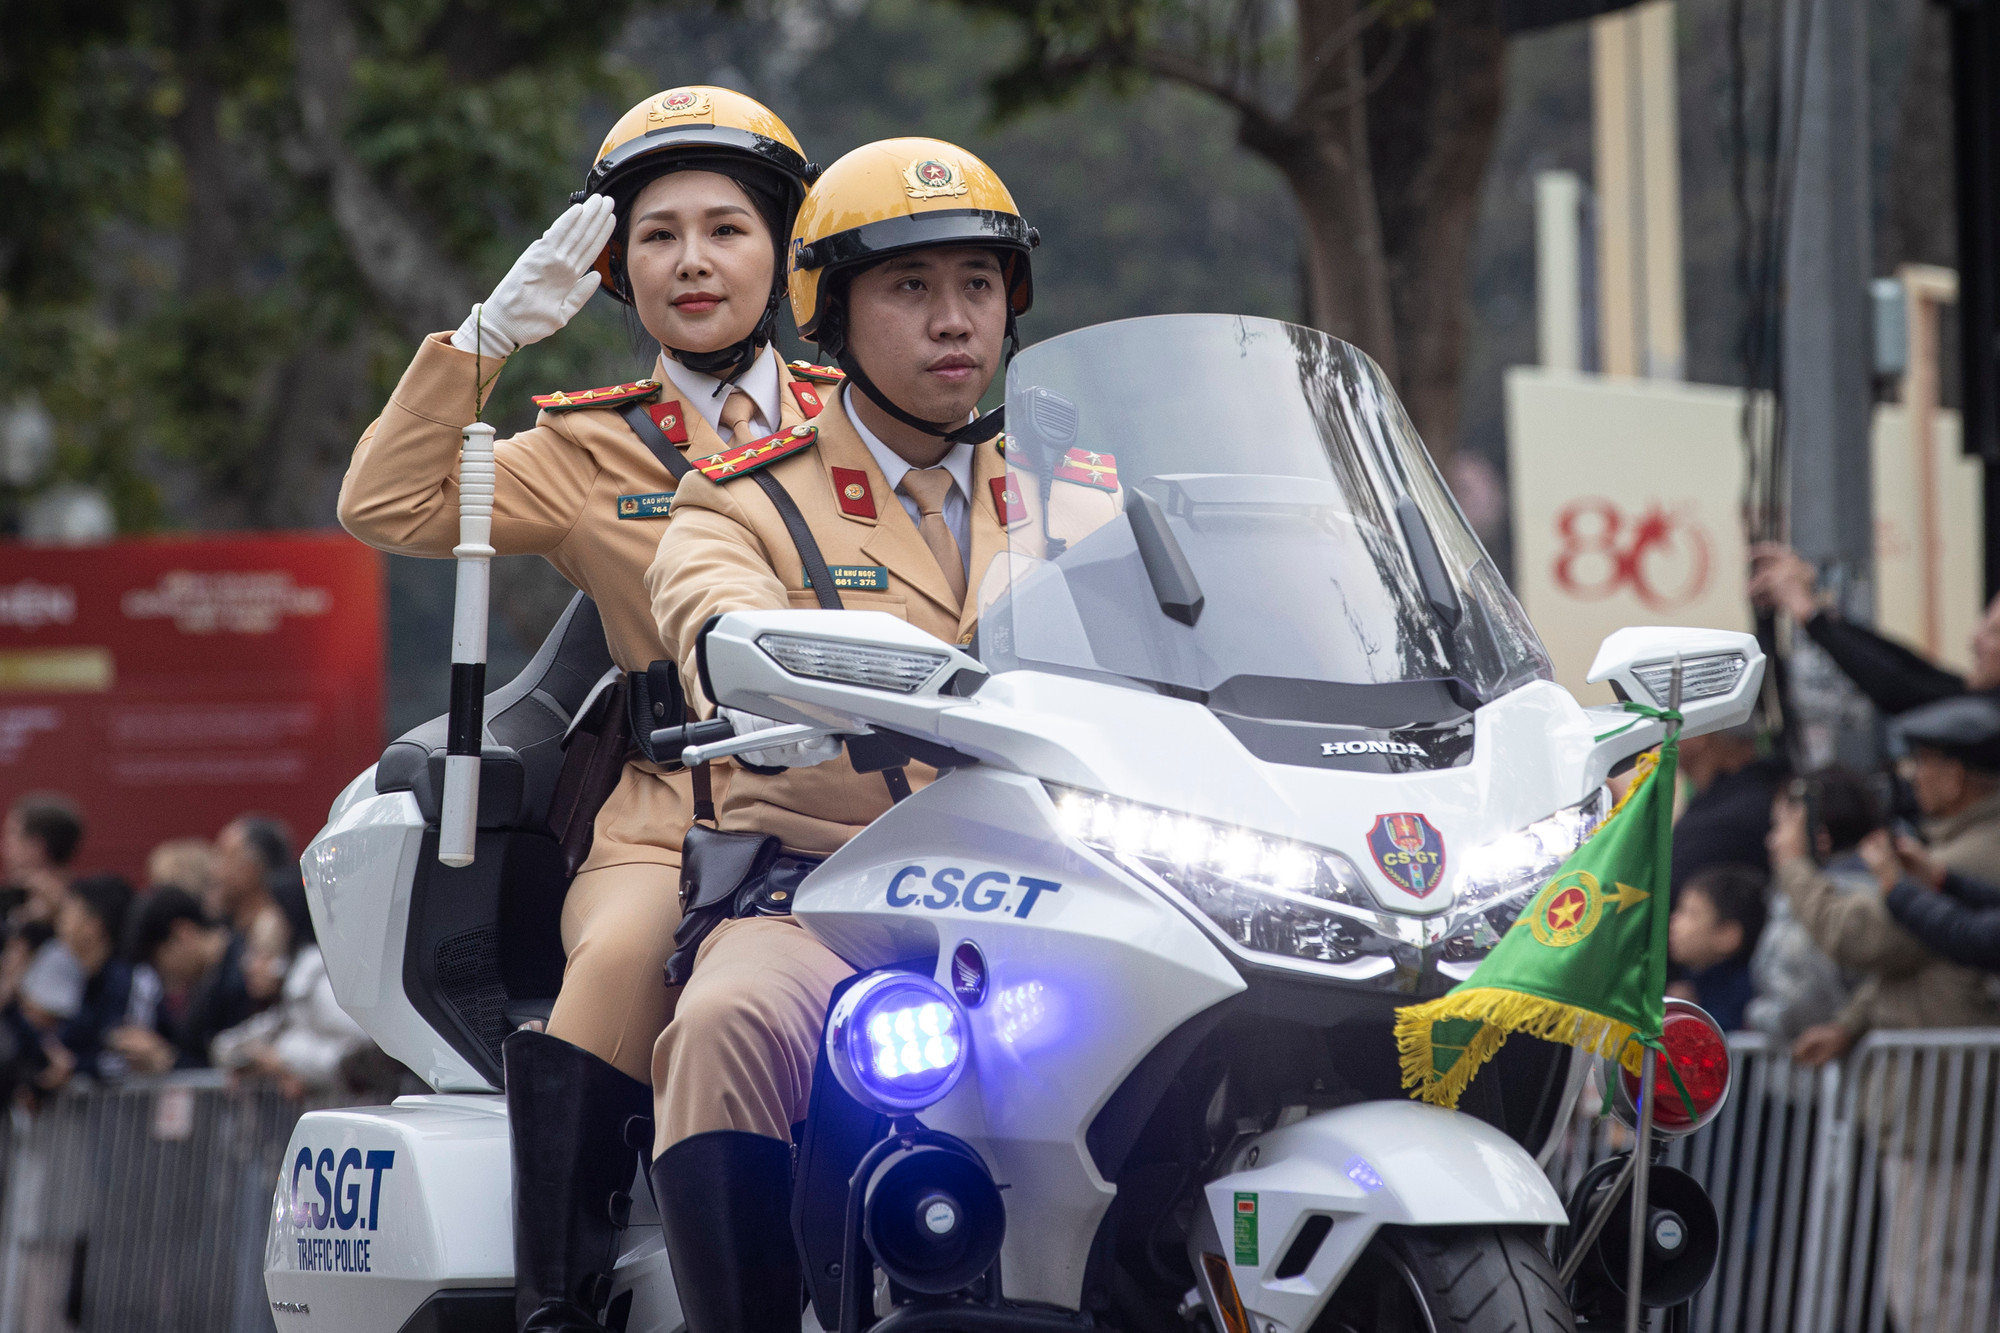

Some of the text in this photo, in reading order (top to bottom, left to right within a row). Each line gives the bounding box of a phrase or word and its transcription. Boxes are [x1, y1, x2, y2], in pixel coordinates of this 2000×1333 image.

[651, 505, 668, 513] 764
[834, 568, 842, 577] LÊ
[858, 570, 876, 579] NGỌC
[834, 578, 852, 586] 661
[1320, 740, 1430, 757] HONDA
[886, 865, 1063, 919] C.S.G.T
[291, 1146, 395, 1231] C.S.G.T
[297, 1238, 371, 1273] TRAFFIC POLICE
